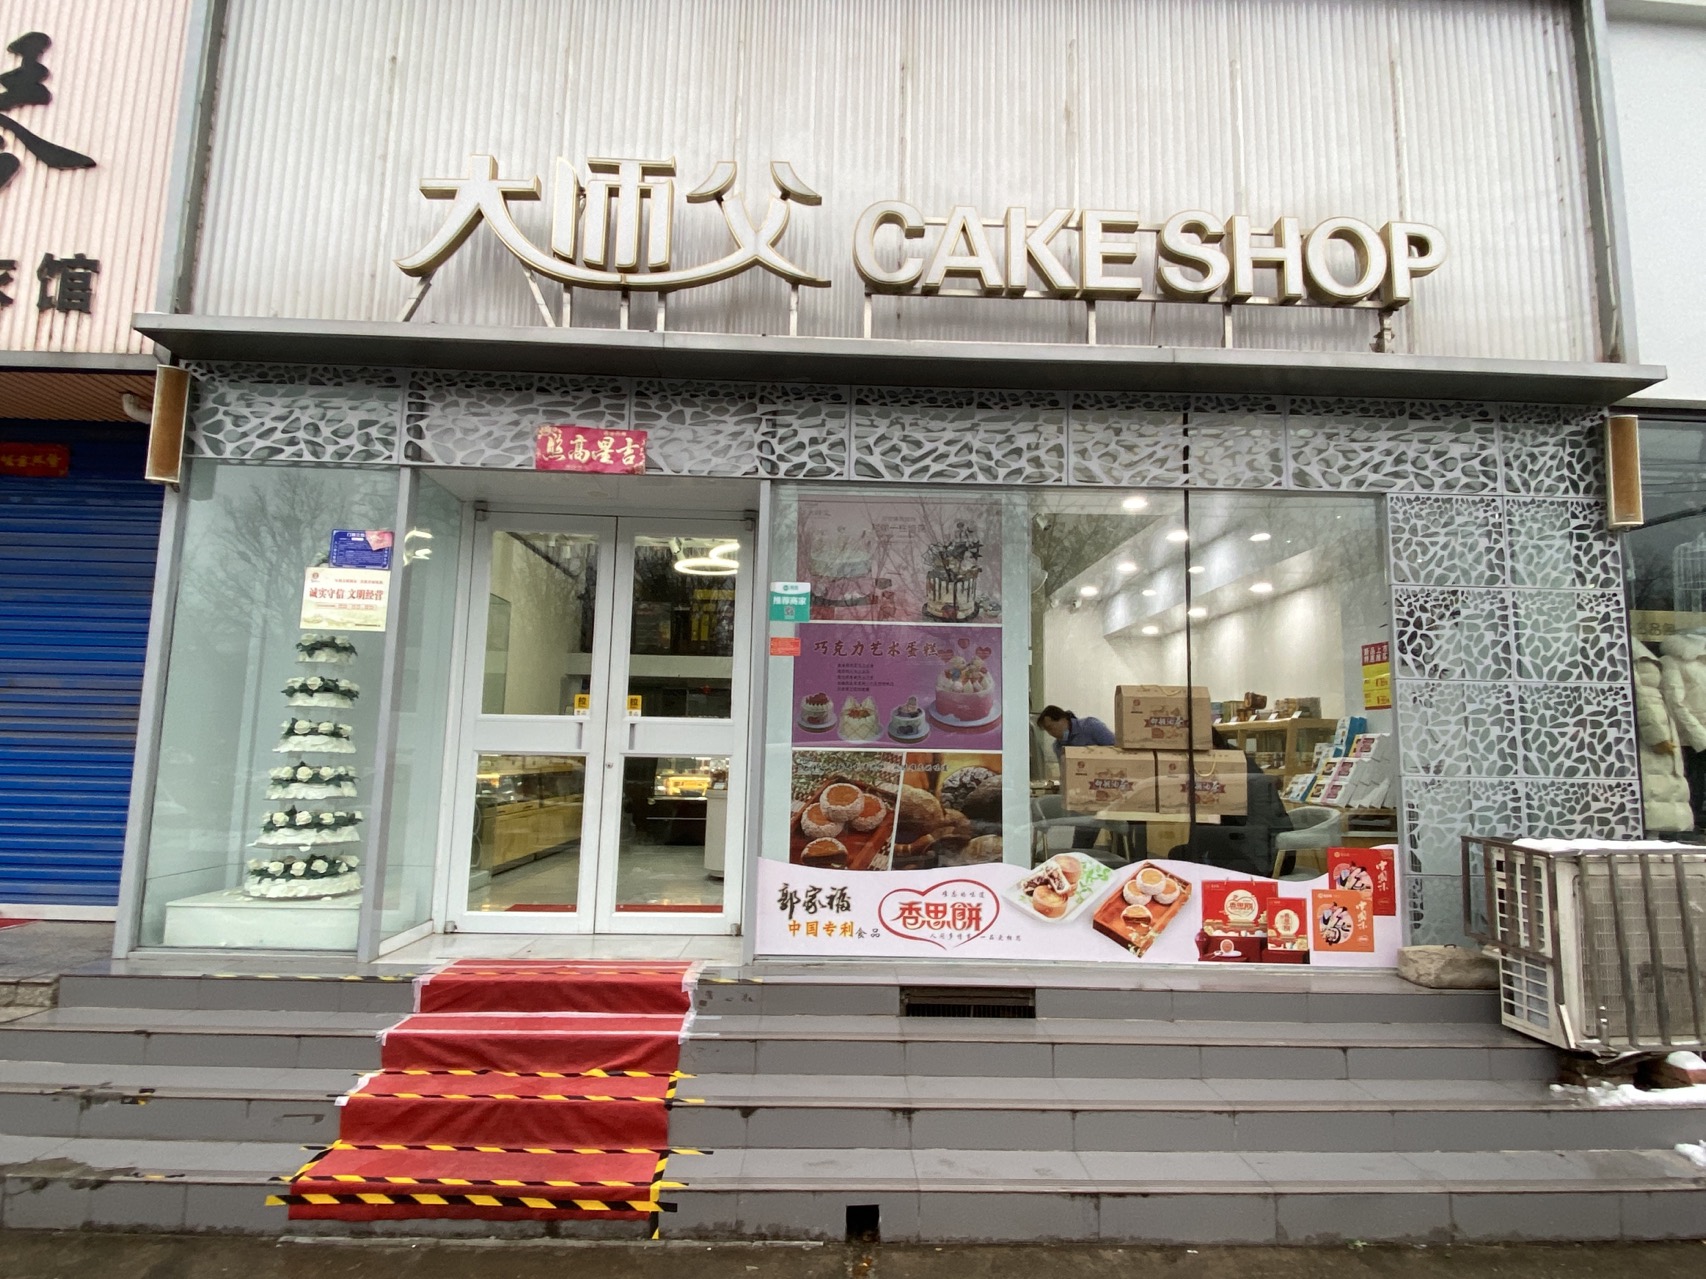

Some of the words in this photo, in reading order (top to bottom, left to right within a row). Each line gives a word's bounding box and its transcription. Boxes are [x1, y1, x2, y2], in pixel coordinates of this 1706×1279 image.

[393, 154, 831, 291] 大师父
[309, 587, 345, 599] 诚实守信
[347, 588, 384, 601] 文明经营
[813, 639, 940, 658] 巧克力艺术蛋糕
[788, 920, 855, 938] 中国专利
[855, 927, 881, 938] 食品
